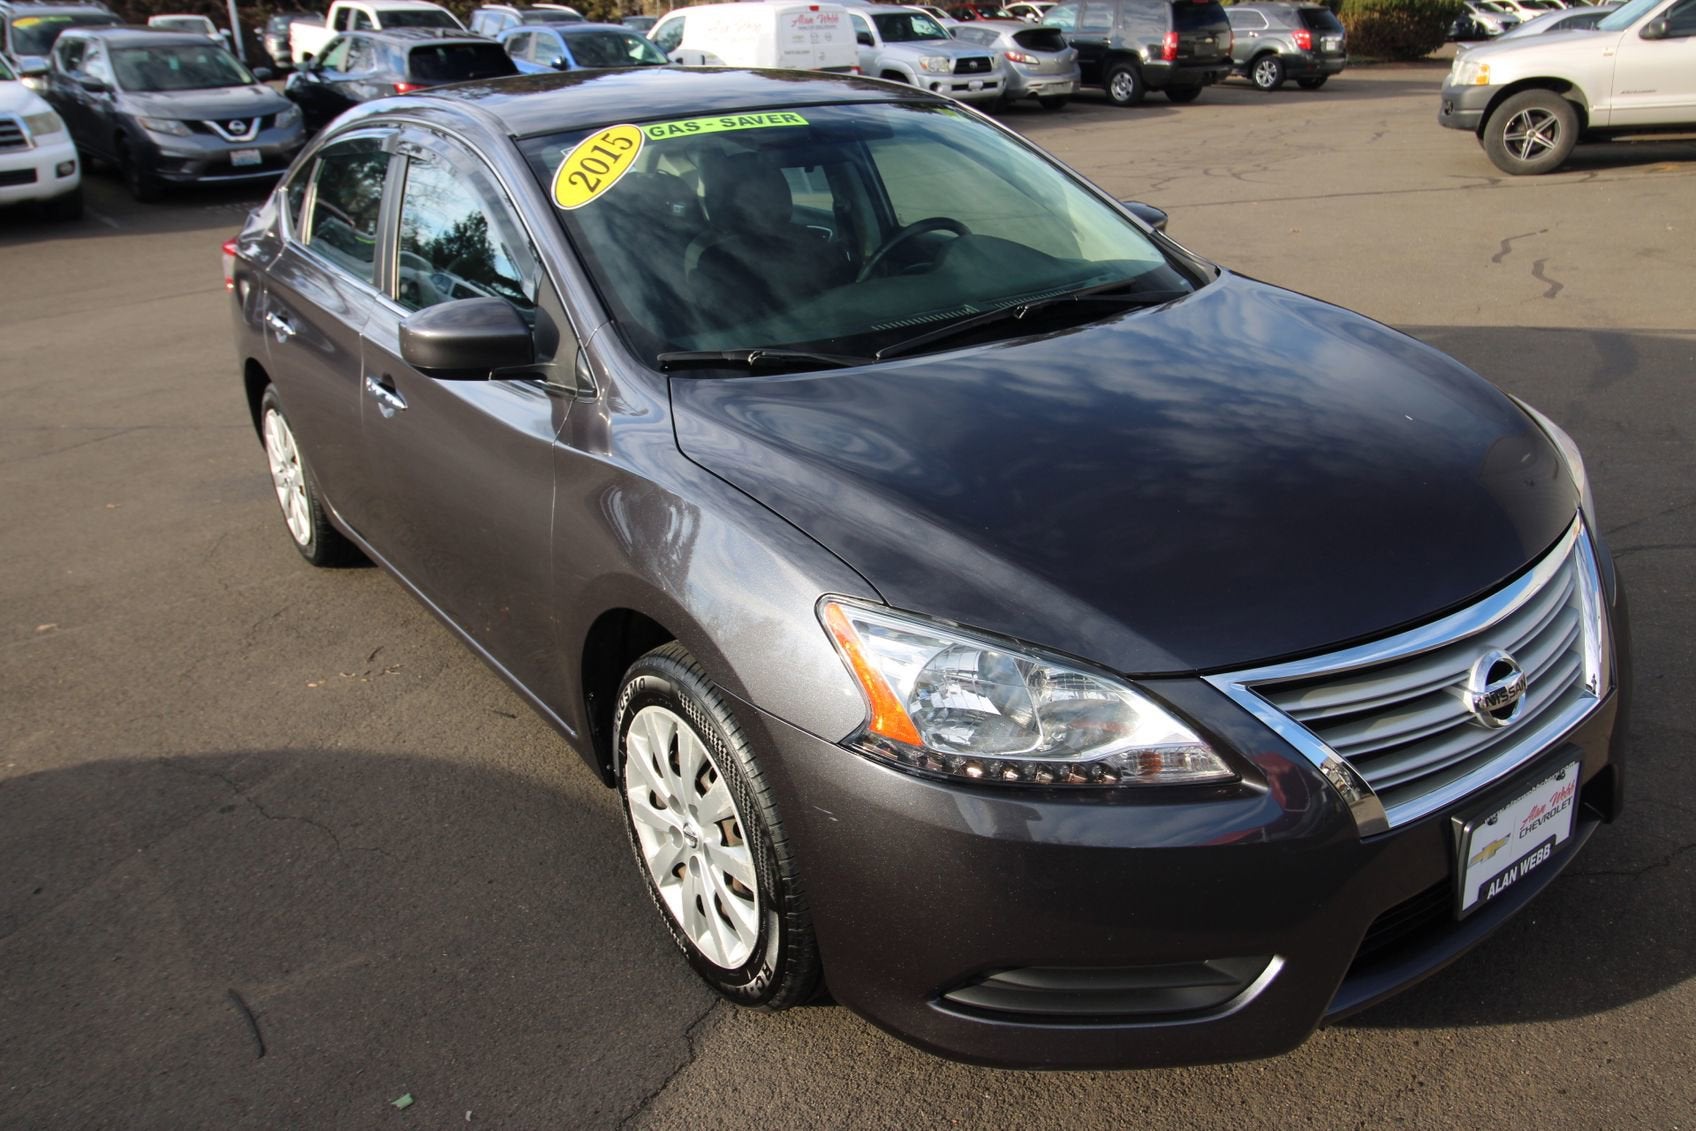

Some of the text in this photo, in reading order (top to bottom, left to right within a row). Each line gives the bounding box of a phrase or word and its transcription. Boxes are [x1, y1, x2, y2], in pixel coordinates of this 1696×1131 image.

[719, 114, 801, 128] SAVER
[568, 133, 634, 193] 2015
[1484, 675, 1527, 708] NISSAN
[1519, 804, 1547, 832] Alan
[1519, 796, 1573, 840] CHEVROLET
[1486, 843, 1551, 900] ALAN WEBB
